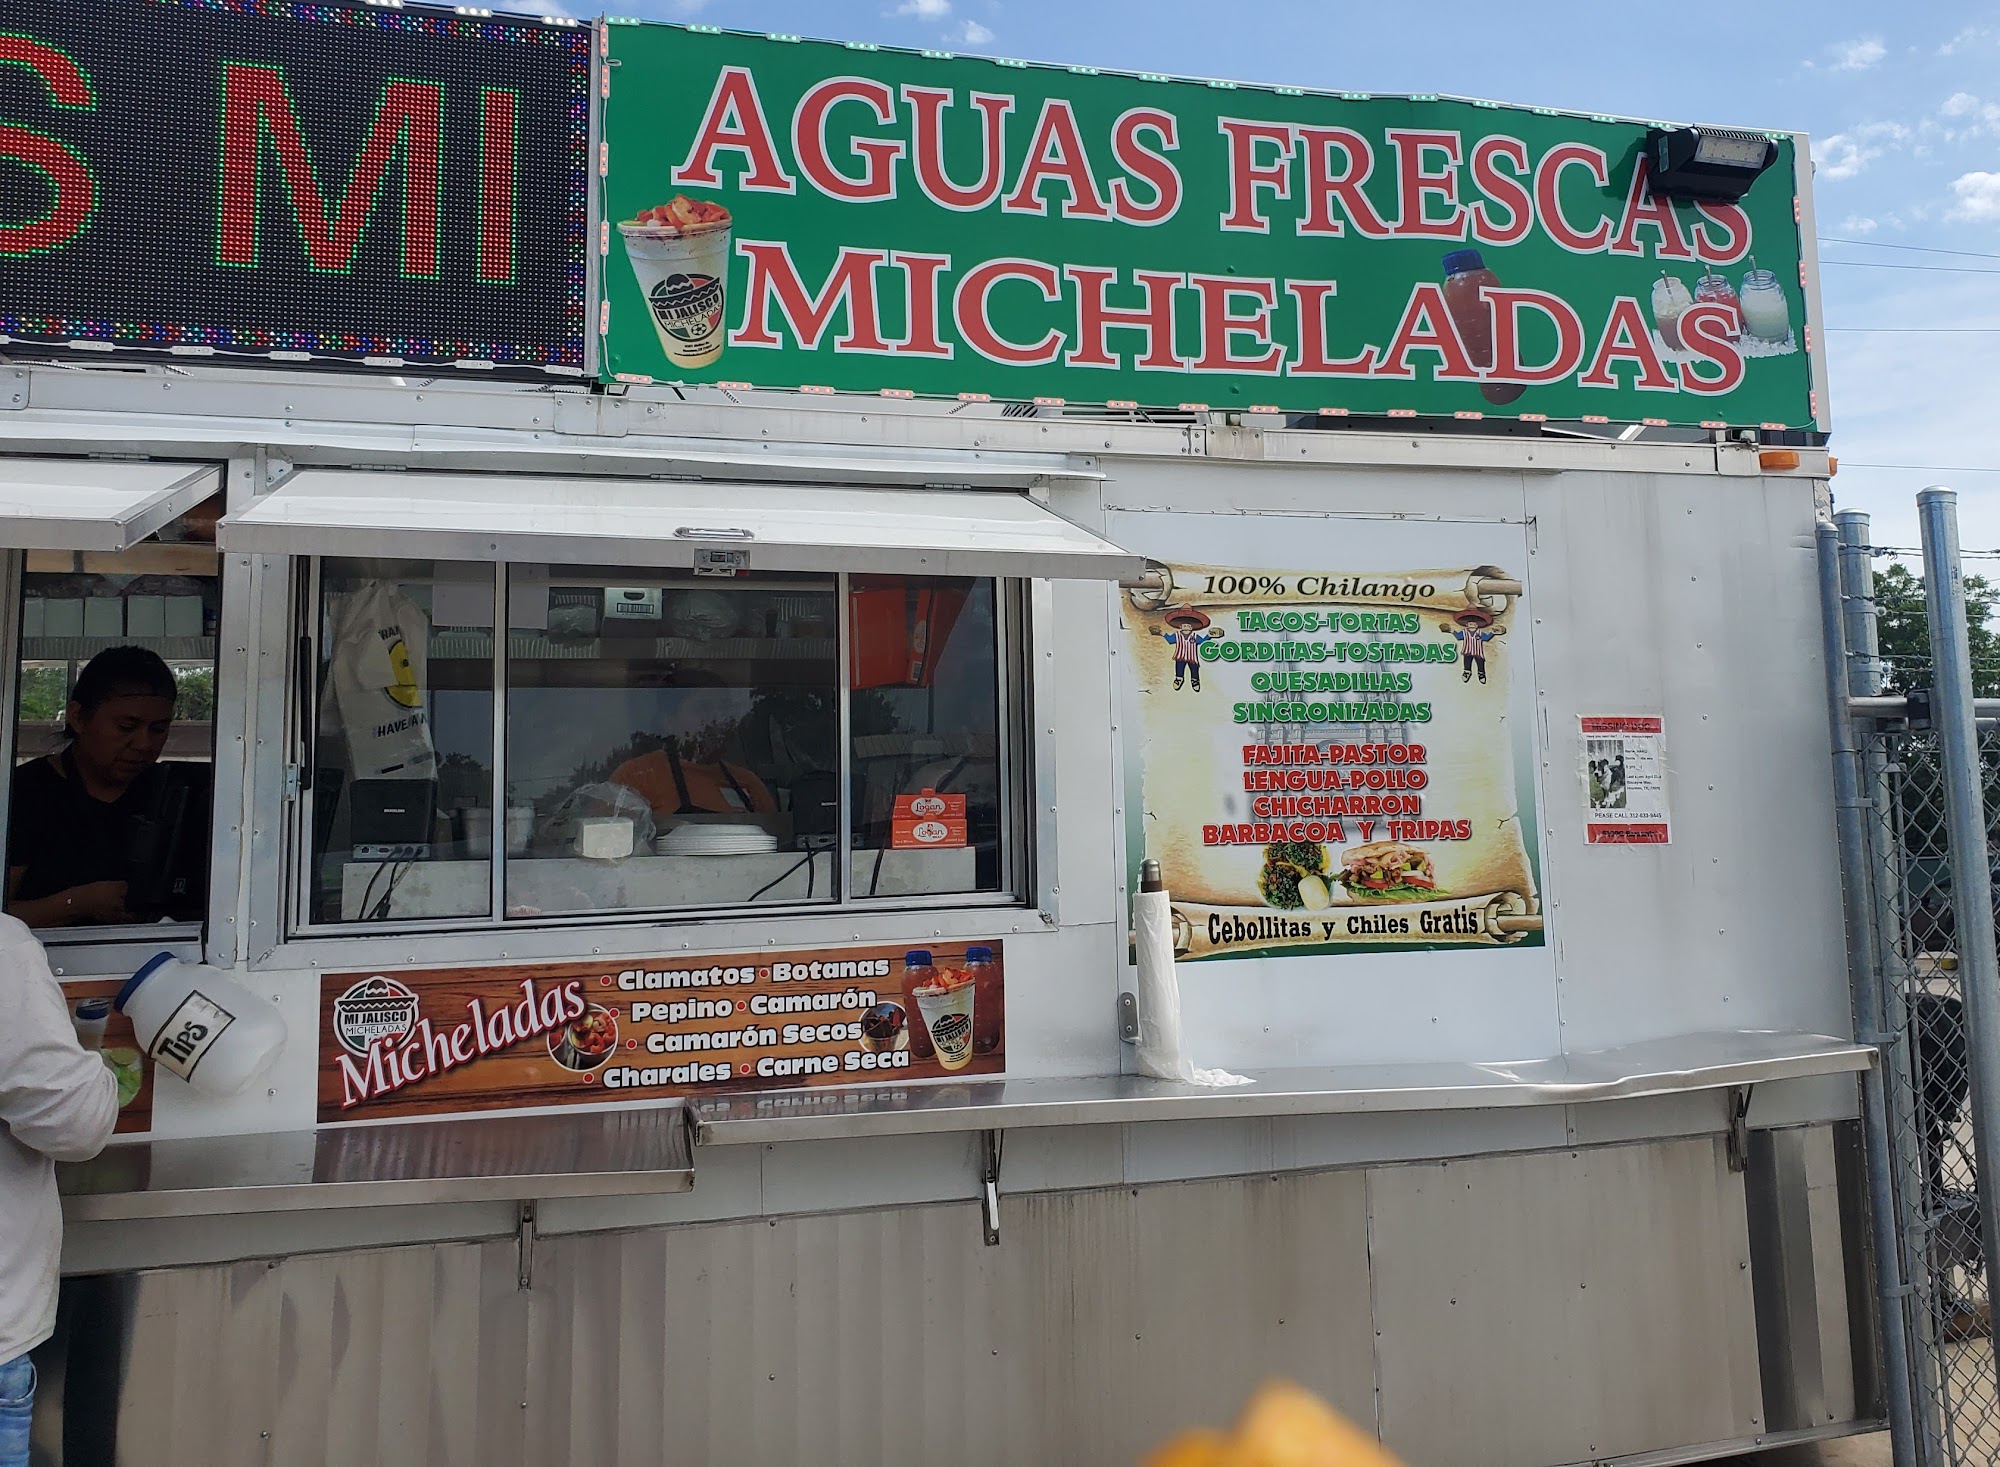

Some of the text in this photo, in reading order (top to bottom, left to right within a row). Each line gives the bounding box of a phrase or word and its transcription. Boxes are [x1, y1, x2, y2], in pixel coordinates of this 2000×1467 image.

[215, 60, 520, 285] MI
[671, 65, 1752, 265] AGUAS FRESCAS
[674, 293, 719, 319] JALISCO
[728, 238, 1746, 397] MICHELADAS
[1203, 576, 1436, 602] 100% Chilango
[1237, 611, 1420, 633] TACOS-TORTAS
[1199, 641, 1459, 663] GORDITAS-TOSTADAS
[1250, 672, 1413, 693] QUESADILLAS
[1233, 702, 1432, 723] SINCRONIZADAS
[377, 719, 408, 737] HAVE
[1242, 744, 1426, 765] FAJITA-PASTOR
[1242, 769, 1429, 791] LENGUA-POLLO
[1253, 794, 1421, 817] CHICHARRON
[1202, 819, 1473, 846] BARBACOA Y TRIPAS
[1208, 905, 1479, 944] Cebollitas y Chiles Gratis
[617, 959, 890, 991] Clamatos Botanas
[344, 1010, 408, 1025] MI JALISCO
[631, 987, 878, 1023] Pepino Camarón
[345, 1023, 407, 1036] MICHELADAS
[647, 1021, 863, 1053] Camarón Secos
[334, 979, 586, 1109] Micheladas
[603, 1049, 911, 1088] Charales Carne Seca
